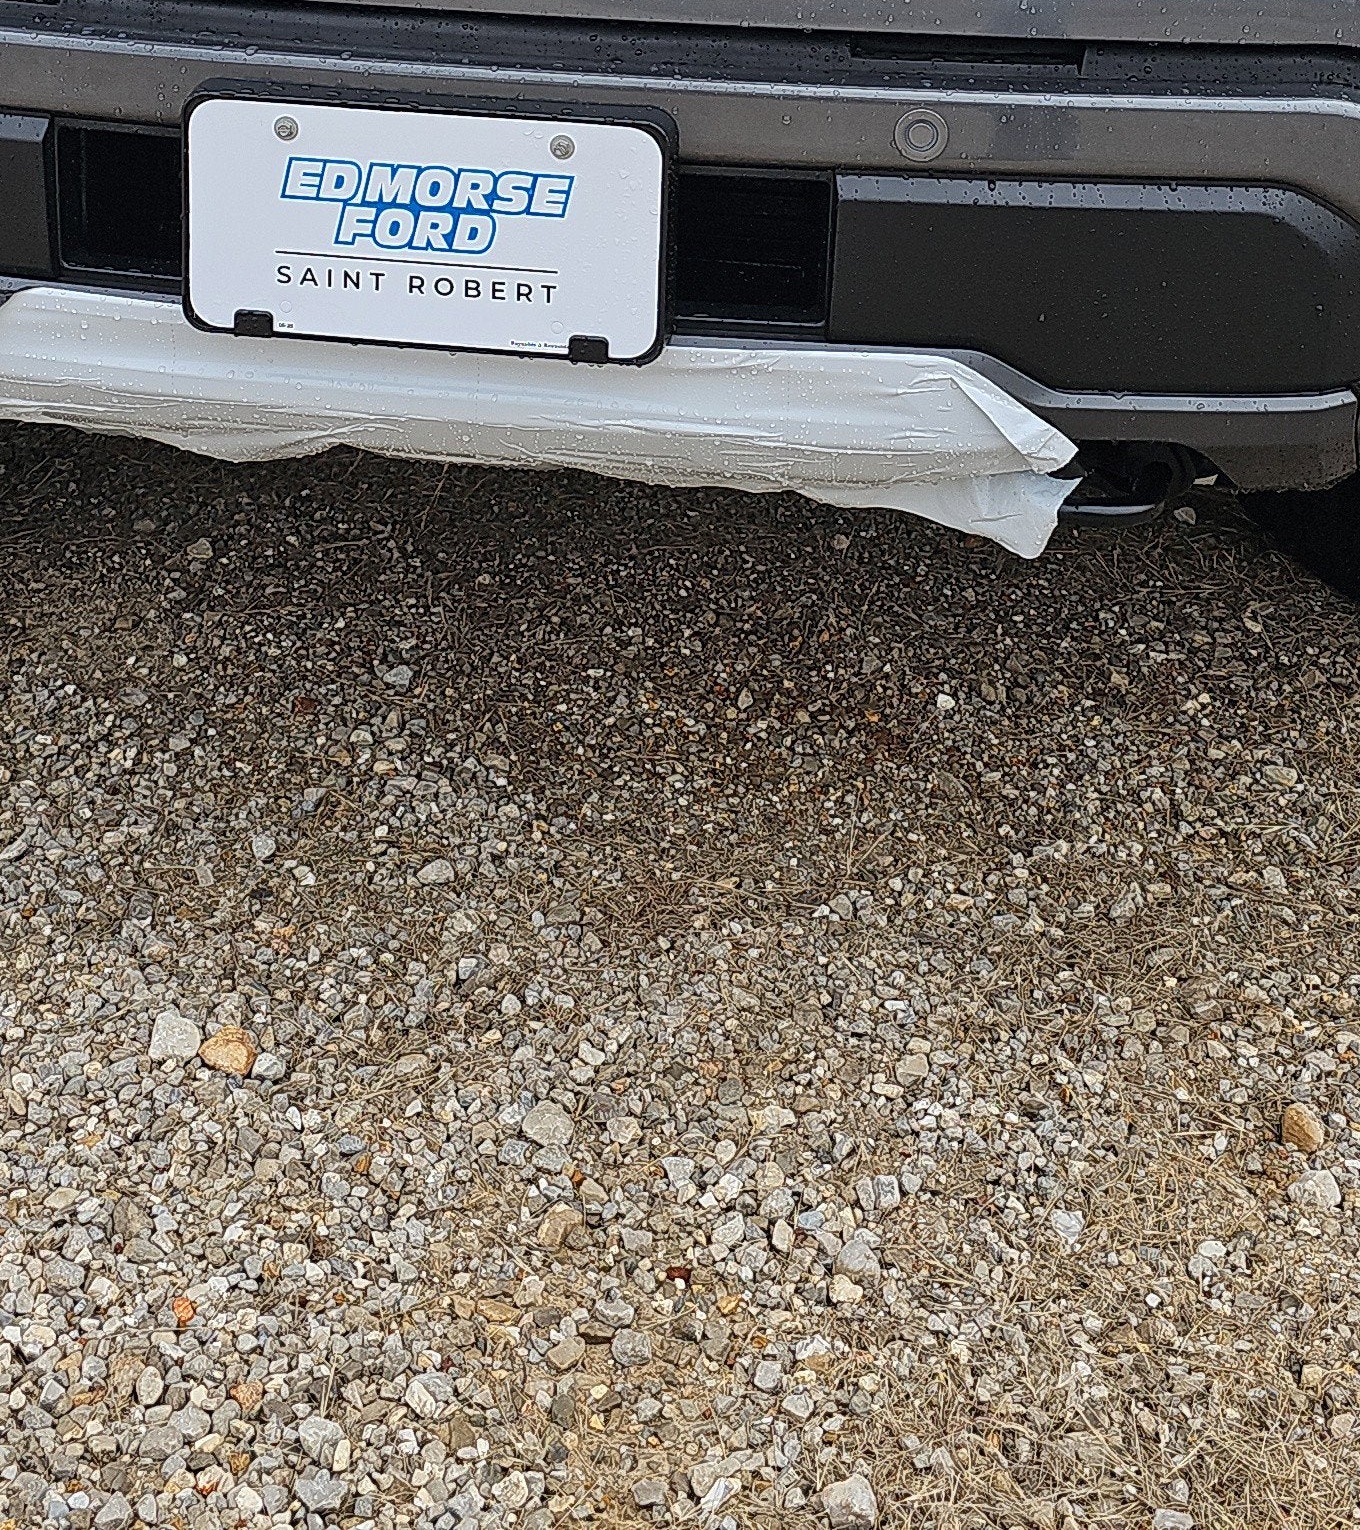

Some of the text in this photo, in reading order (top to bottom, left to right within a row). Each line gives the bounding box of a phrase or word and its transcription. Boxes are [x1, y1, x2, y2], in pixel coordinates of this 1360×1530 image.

[280, 156, 574, 218] ED MORSE
[333, 203, 496, 254] FORD
[276, 265, 556, 303] SAINT ROBERT
